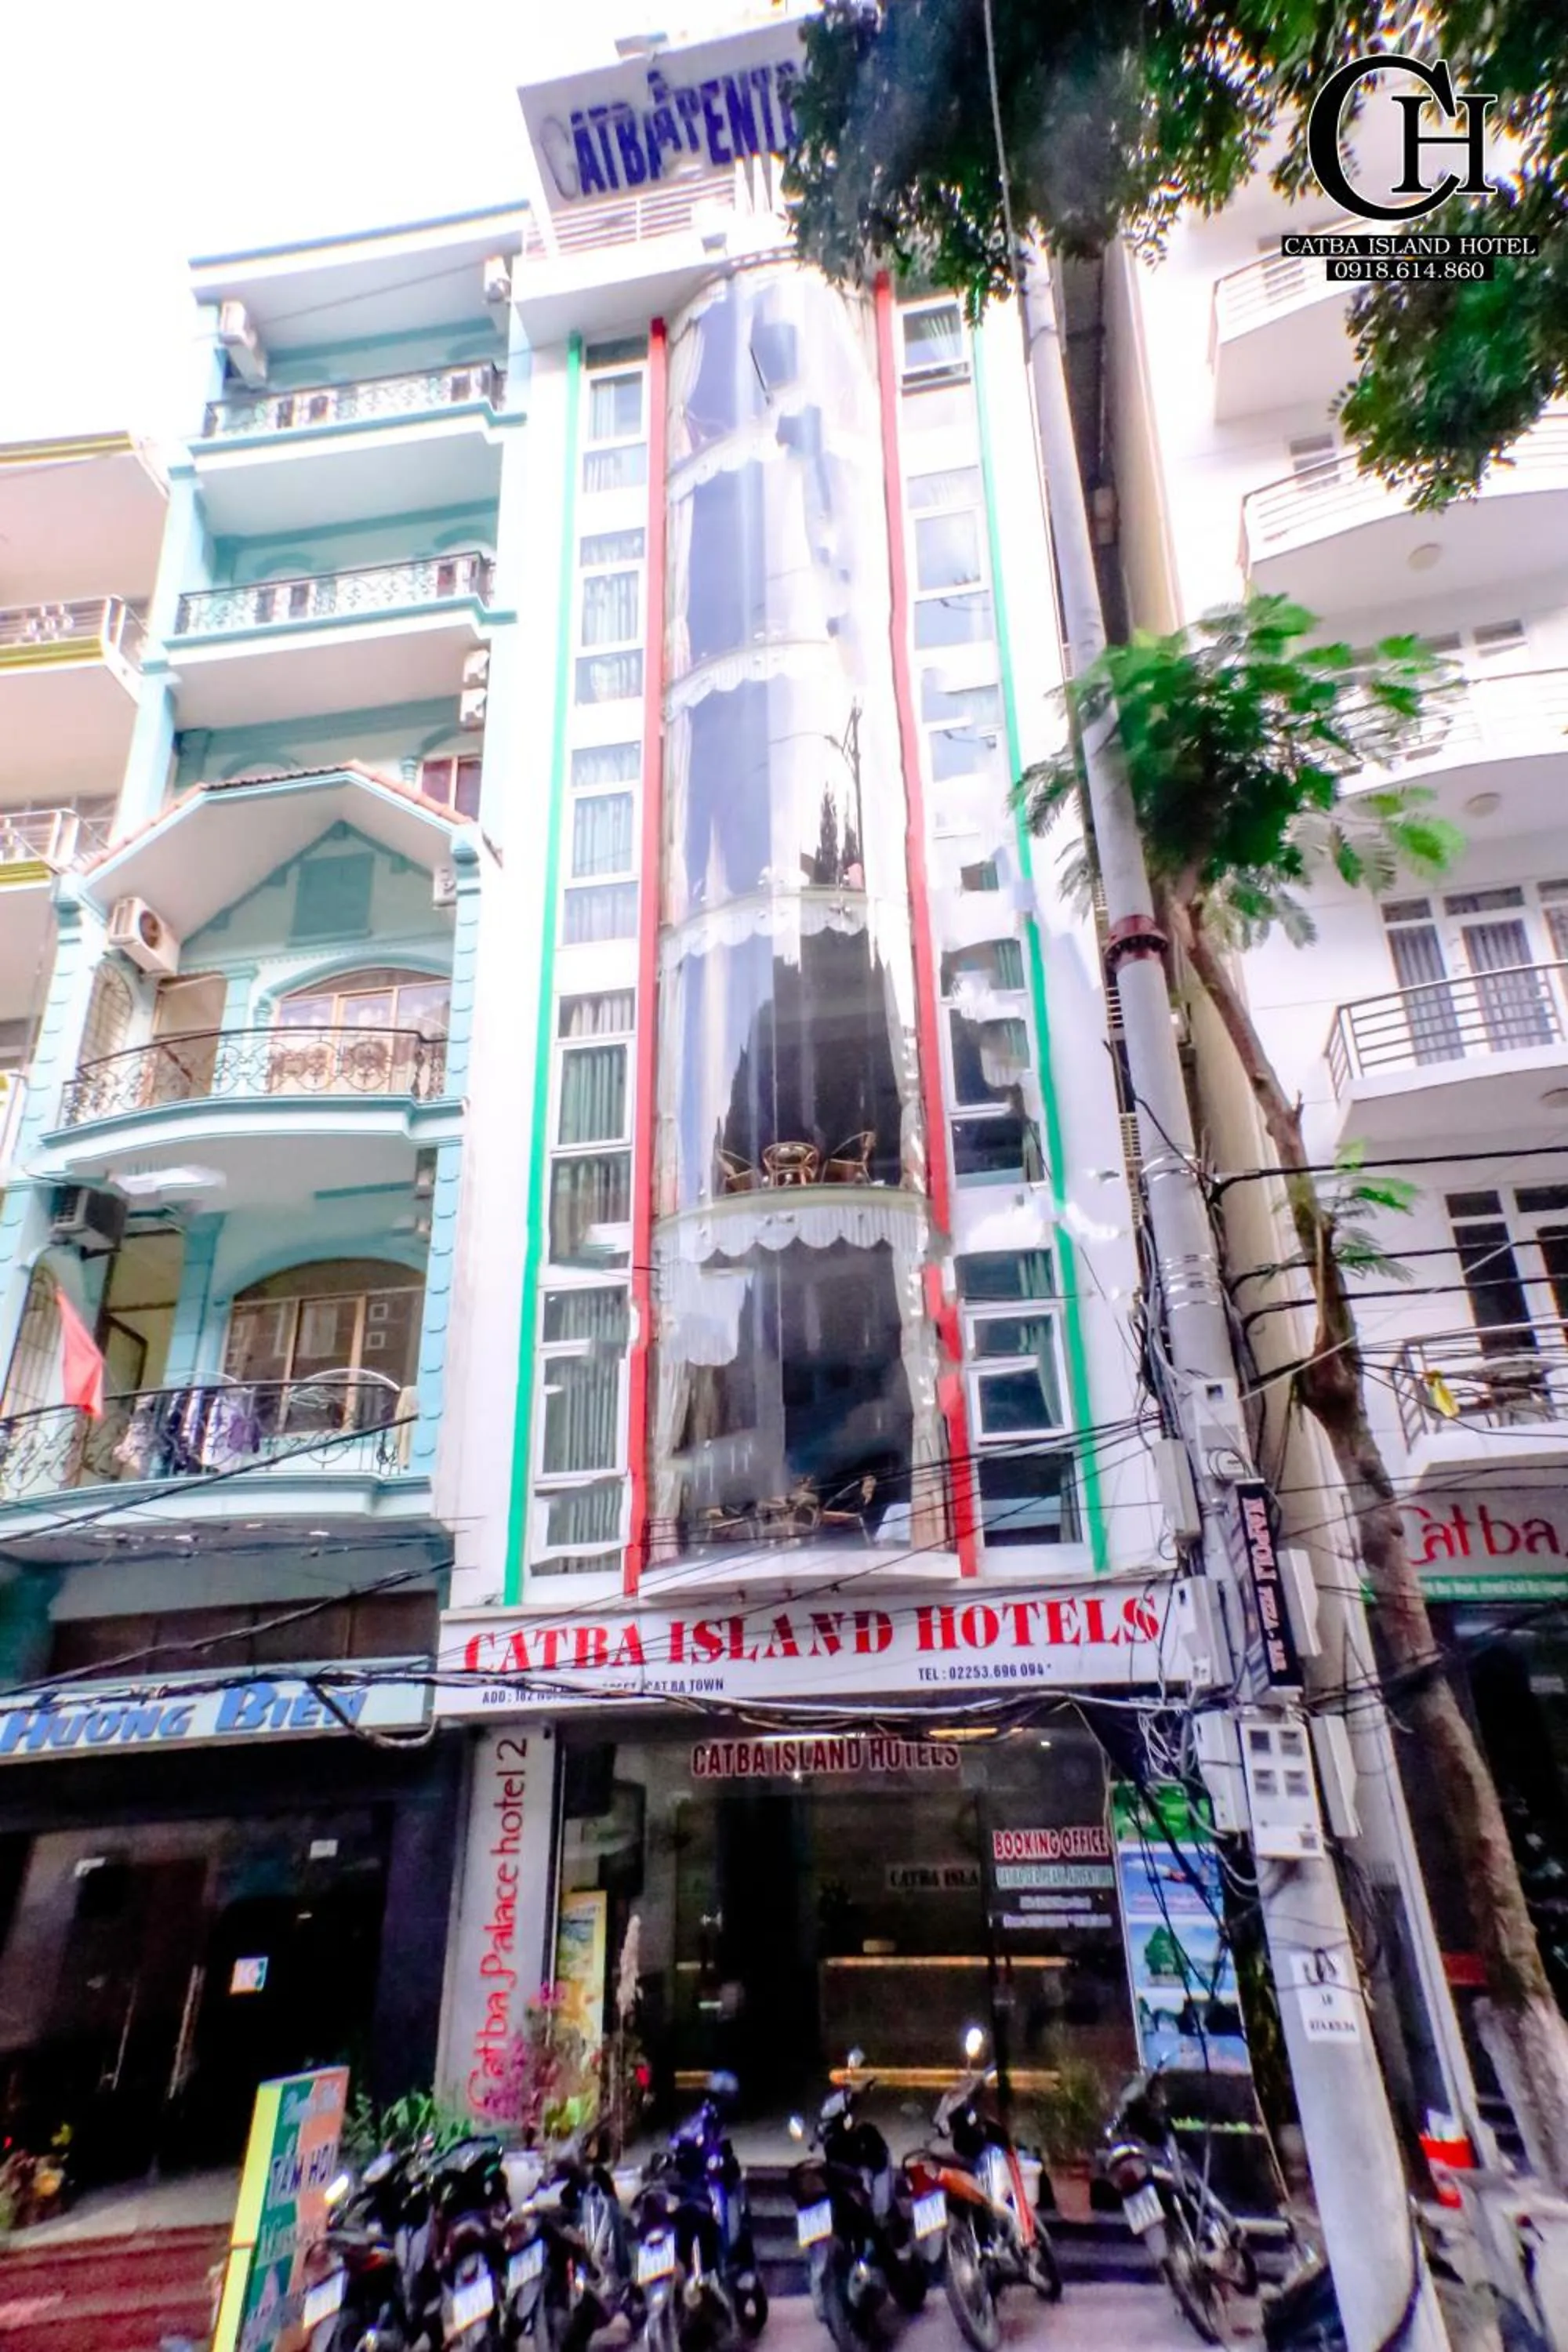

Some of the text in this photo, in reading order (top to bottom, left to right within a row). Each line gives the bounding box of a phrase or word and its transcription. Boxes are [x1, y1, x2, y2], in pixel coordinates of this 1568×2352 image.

[463, 1595, 1160, 1673] CATBA ISLAND HOTELS
[689, 1676, 724, 1693] TOWN
[496, 1737, 528, 1761] 2
[693, 1740, 768, 1777] CATBA
[773, 1737, 861, 1773] ISLAND
[489, 1770, 526, 1856] hotel
[993, 1827, 1109, 1859] BOOKING OFFICE
[479, 1863, 520, 1988] Palace
